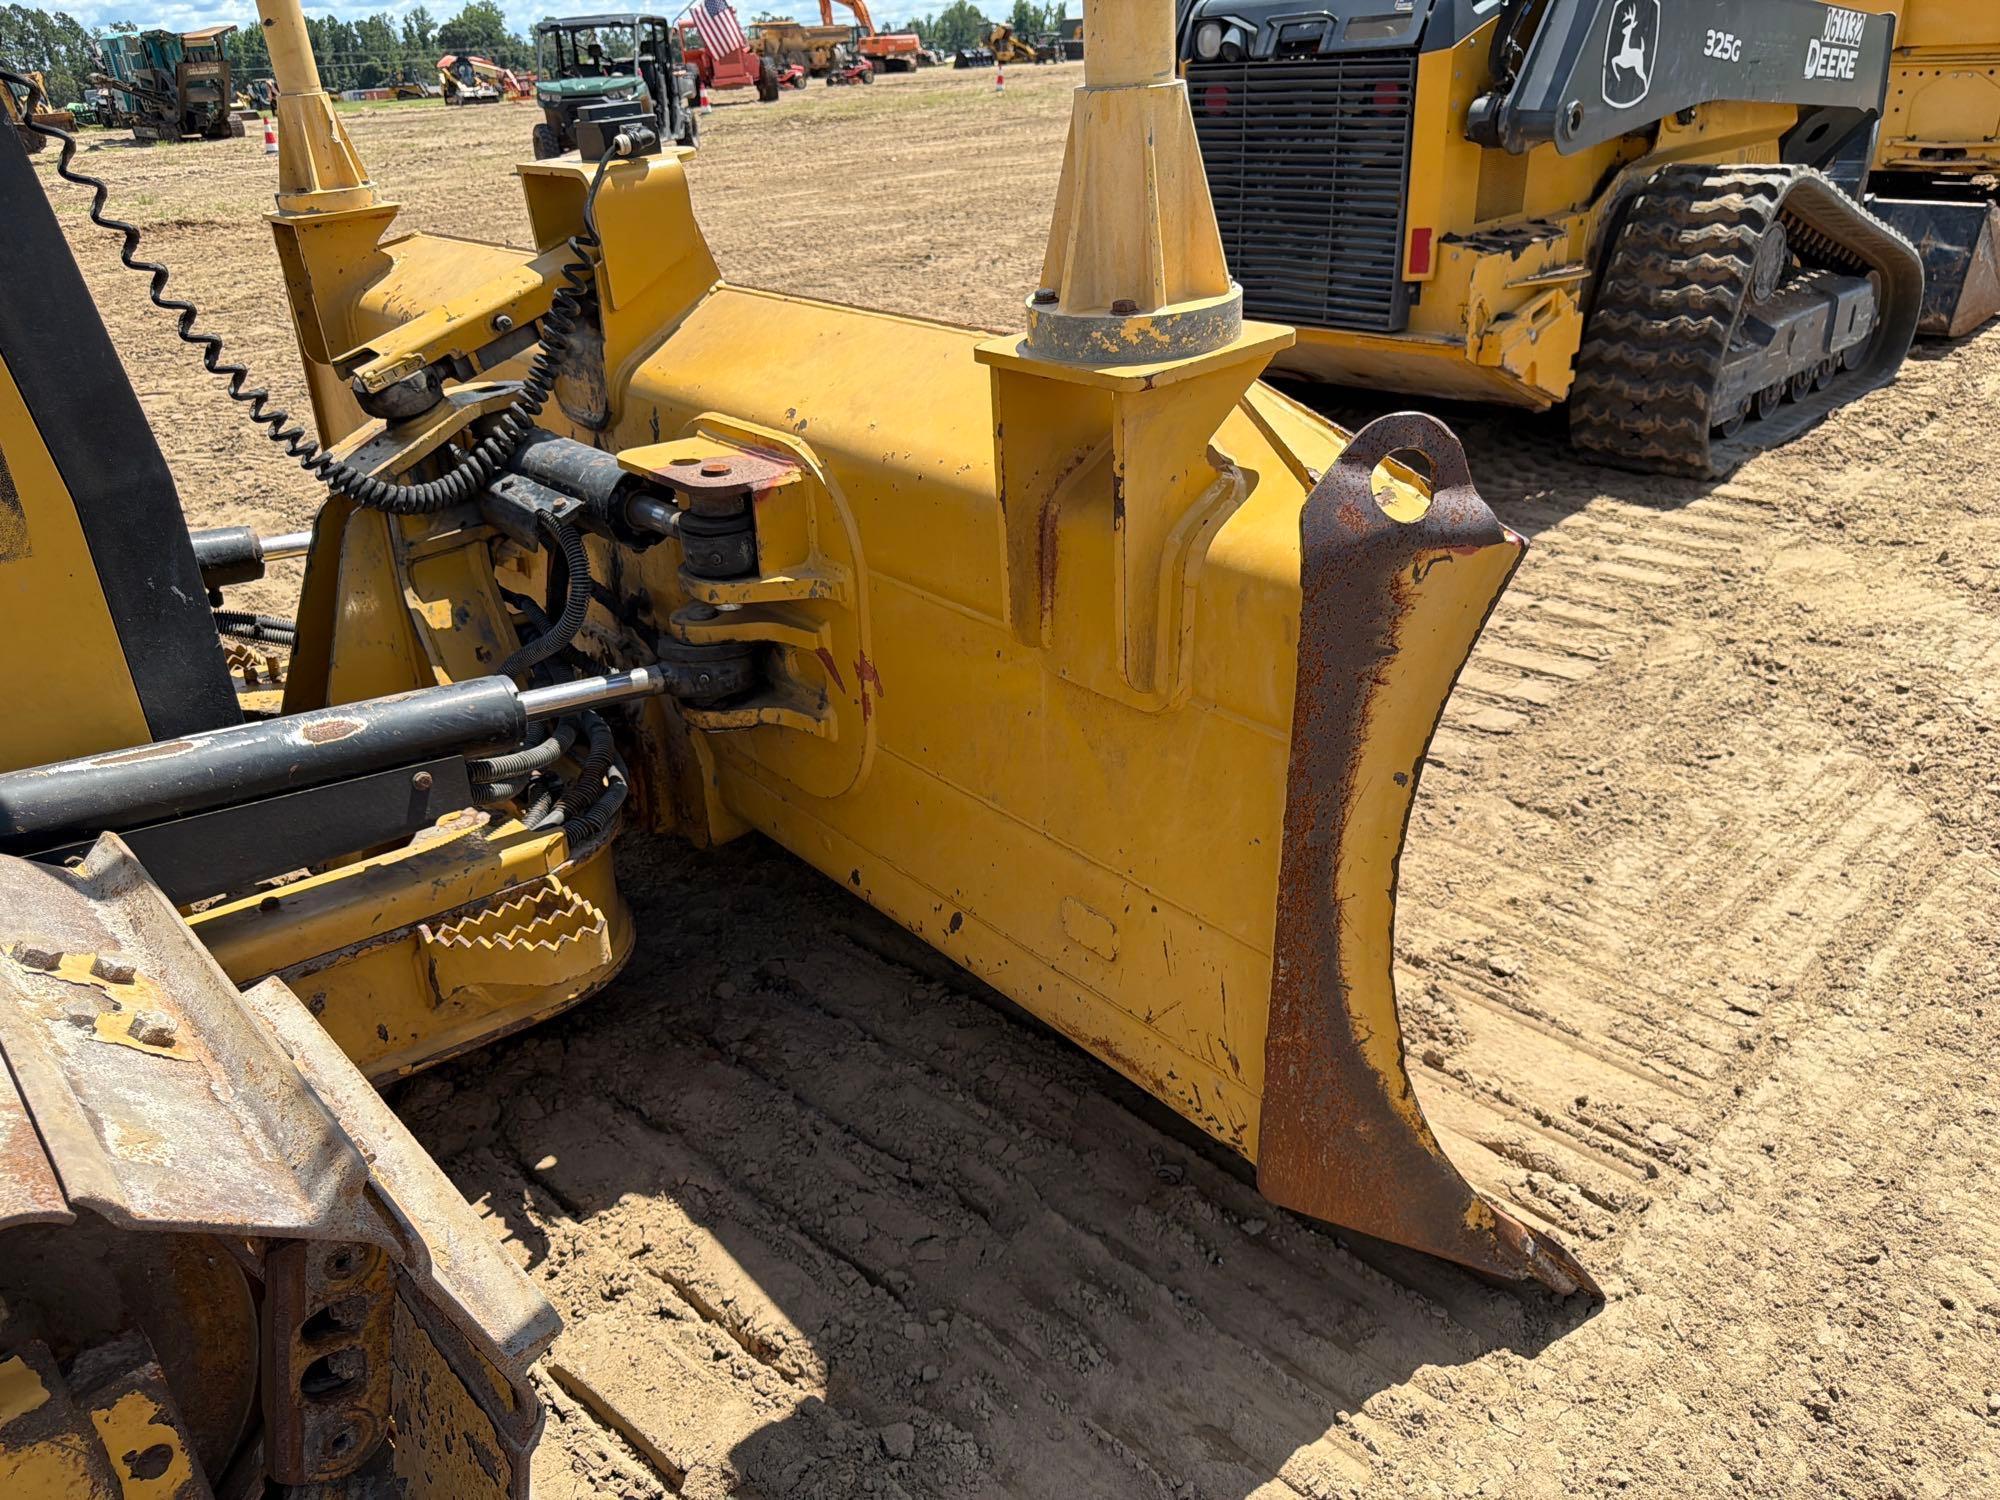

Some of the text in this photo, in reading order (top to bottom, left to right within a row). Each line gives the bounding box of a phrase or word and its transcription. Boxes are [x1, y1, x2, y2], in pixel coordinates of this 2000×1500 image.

[1703, 29, 1742, 62] 325G
[1822, 8, 1865, 46] 061132
[1804, 38, 1859, 79] DEERE
